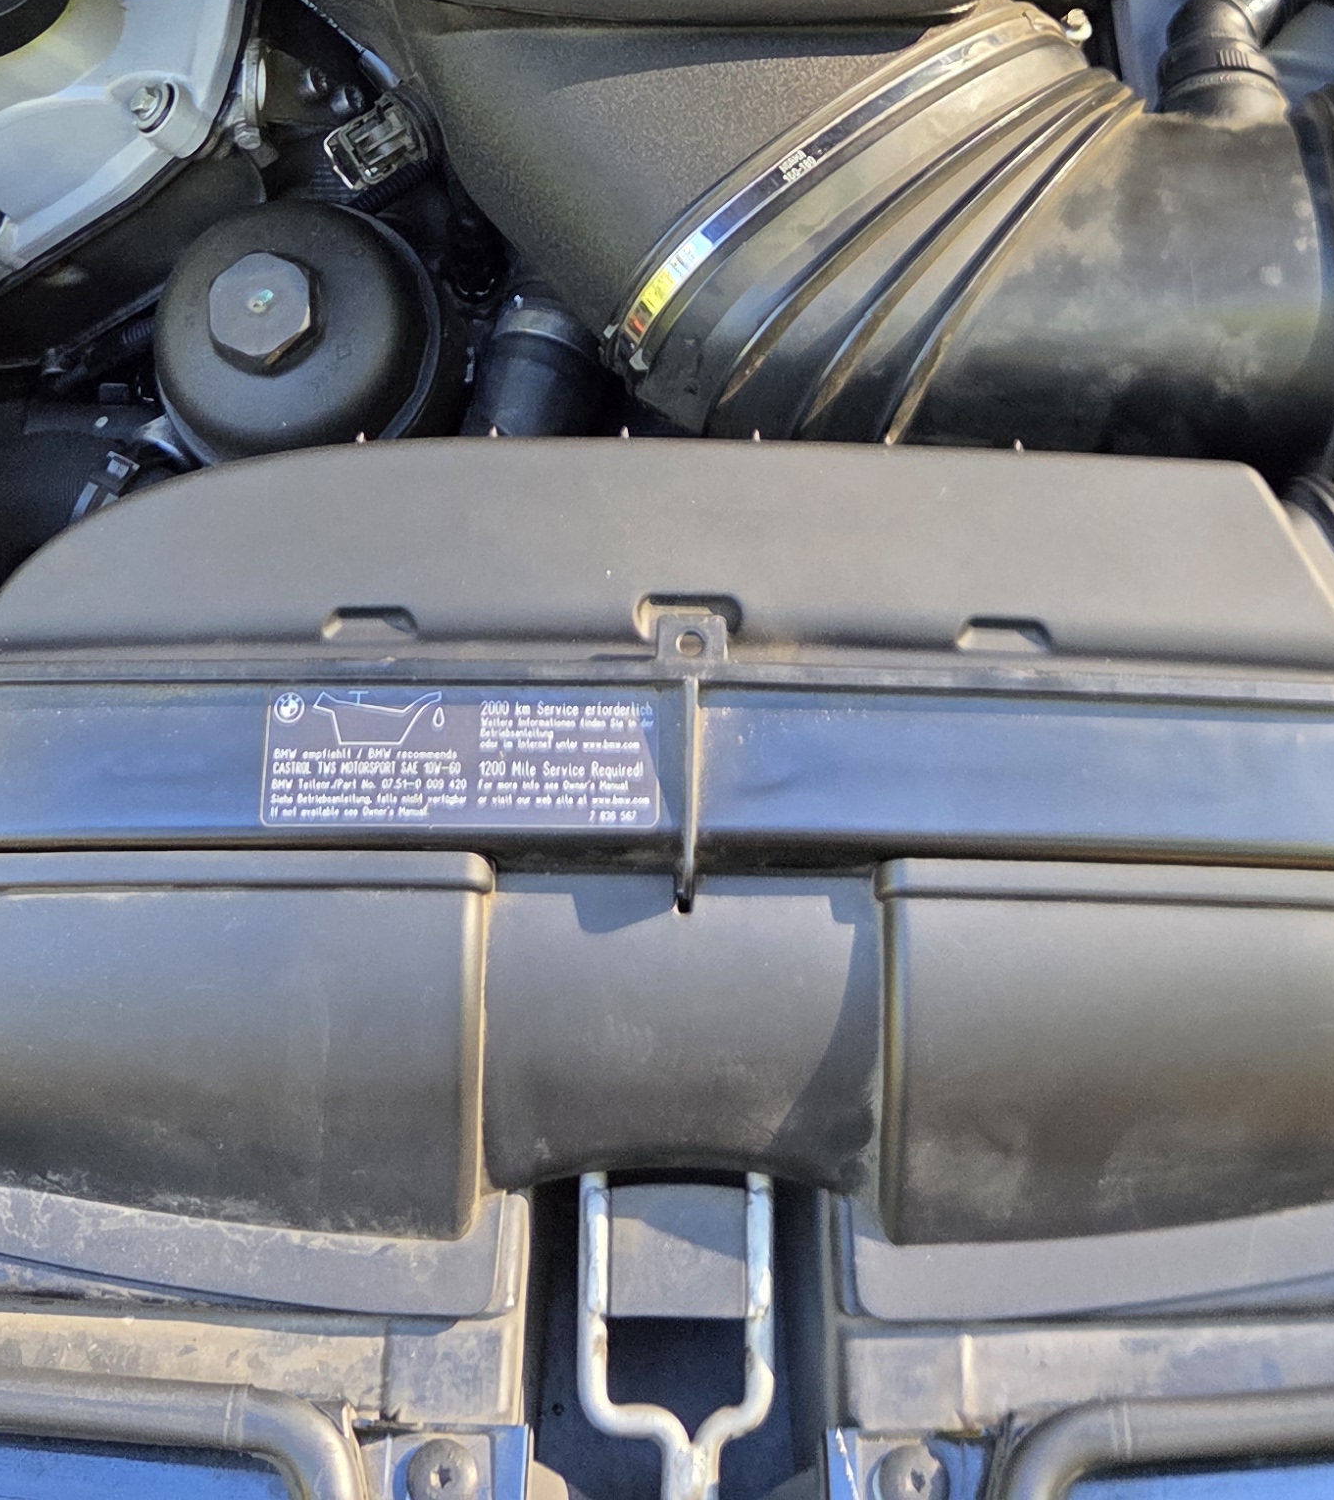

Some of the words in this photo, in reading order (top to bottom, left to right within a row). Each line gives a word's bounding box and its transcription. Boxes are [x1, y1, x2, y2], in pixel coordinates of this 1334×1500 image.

[778, 150, 807, 174] NORMA
[480, 700, 510, 716] 2000
[514, 700, 531, 716] km
[537, 700, 579, 716] Service
[585, 700, 653, 716] erforderlich
[480, 717, 513, 728] Weitere
[518, 717, 576, 728] Informationen
[580, 717, 606, 728] finden
[610, 717, 624, 728] Sie
[628, 717, 637, 728] in
[640, 717, 654, 728] der
[479, 728, 554, 739] Betriebsanleitung
[479, 739, 498, 749] oder
[503, 739, 513, 749] im
[517, 739, 553, 749] Internet
[555, 739, 578, 749] unter
[582, 739, 641, 749] www.bmw.com
[273, 749, 297, 759] BMW
[302, 749, 351, 760] empfiehlt
[368, 749, 392, 759] BMW
[397, 749, 457, 759] recommends
[272, 761, 312, 774] CASTROL
[317, 761, 336, 774] TWS
[340, 761, 396, 774] MOTORSPORT
[400, 761, 419, 774] SAE
[423, 761, 461, 774] 10W-60
[478, 761, 506, 776] 1200
[511, 761, 537, 776] Mile
[543, 761, 585, 776] Service
[591, 761, 644, 778] Required!
[271, 778, 293, 789] BMW
[361, 778, 376, 789] No.
[381, 778, 422, 789] 07.51-0
[426, 778, 444, 789] 009
[449, 778, 467, 789] 420
[477, 780, 493, 790] For
[497, 780, 518, 790] more
[544, 780, 559, 790] see
[562, 780, 596, 790] Owner's
[599, 780, 629, 790] Manual
[271, 793, 294, 804] Siehe
[377, 793, 398, 804] falls
[477, 794, 487, 804] or
[492, 794, 513, 804] visit
[516, 794, 531, 804] our
[535, 794, 552, 804] web
[555, 794, 574, 804] site
[576, 794, 587, 804] at
[592, 794, 650, 804] www.bmw.com
[270, 806, 278, 817] If
[282, 806, 297, 817] not
[300, 806, 340, 817] available
[344, 806, 358, 817] see
[362, 806, 394, 817] Owner's
[589, 810, 595, 821] 7
[619, 810, 637, 821] 567
